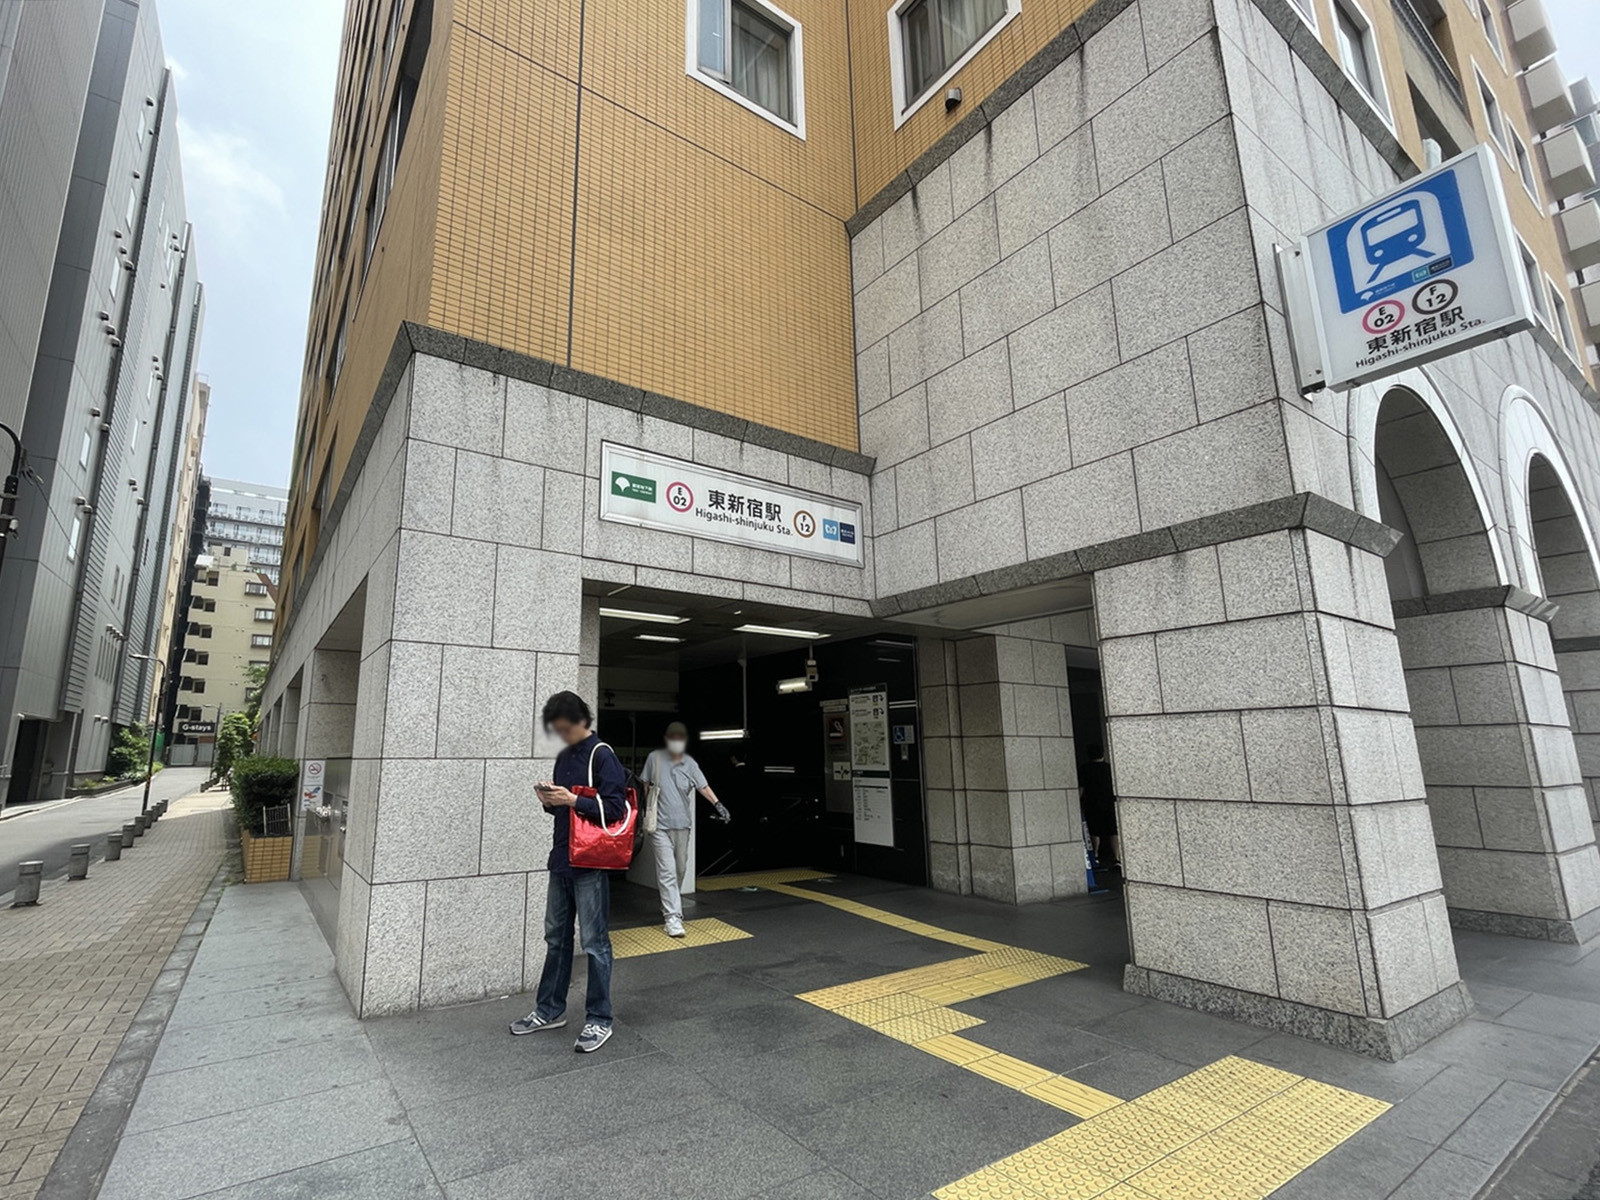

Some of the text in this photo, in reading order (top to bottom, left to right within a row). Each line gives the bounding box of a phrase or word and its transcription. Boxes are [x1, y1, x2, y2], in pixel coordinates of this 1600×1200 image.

[1429, 285, 1437, 296] F
[1425, 293, 1447, 308] 12
[1379, 306, 1386, 316] E
[1373, 313, 1395, 328] 02
[1366, 305, 1465, 355] 東新宿駅
[1355, 318, 1486, 369] Higashi-shinjuku Sta.
[677, 487, 682, 496] E
[673, 495, 687, 507] 02
[708, 489, 782, 523] 東新宿駅
[695, 507, 794, 536] Higashi-shinjuku Sta.
[800, 523, 811, 533] 12
